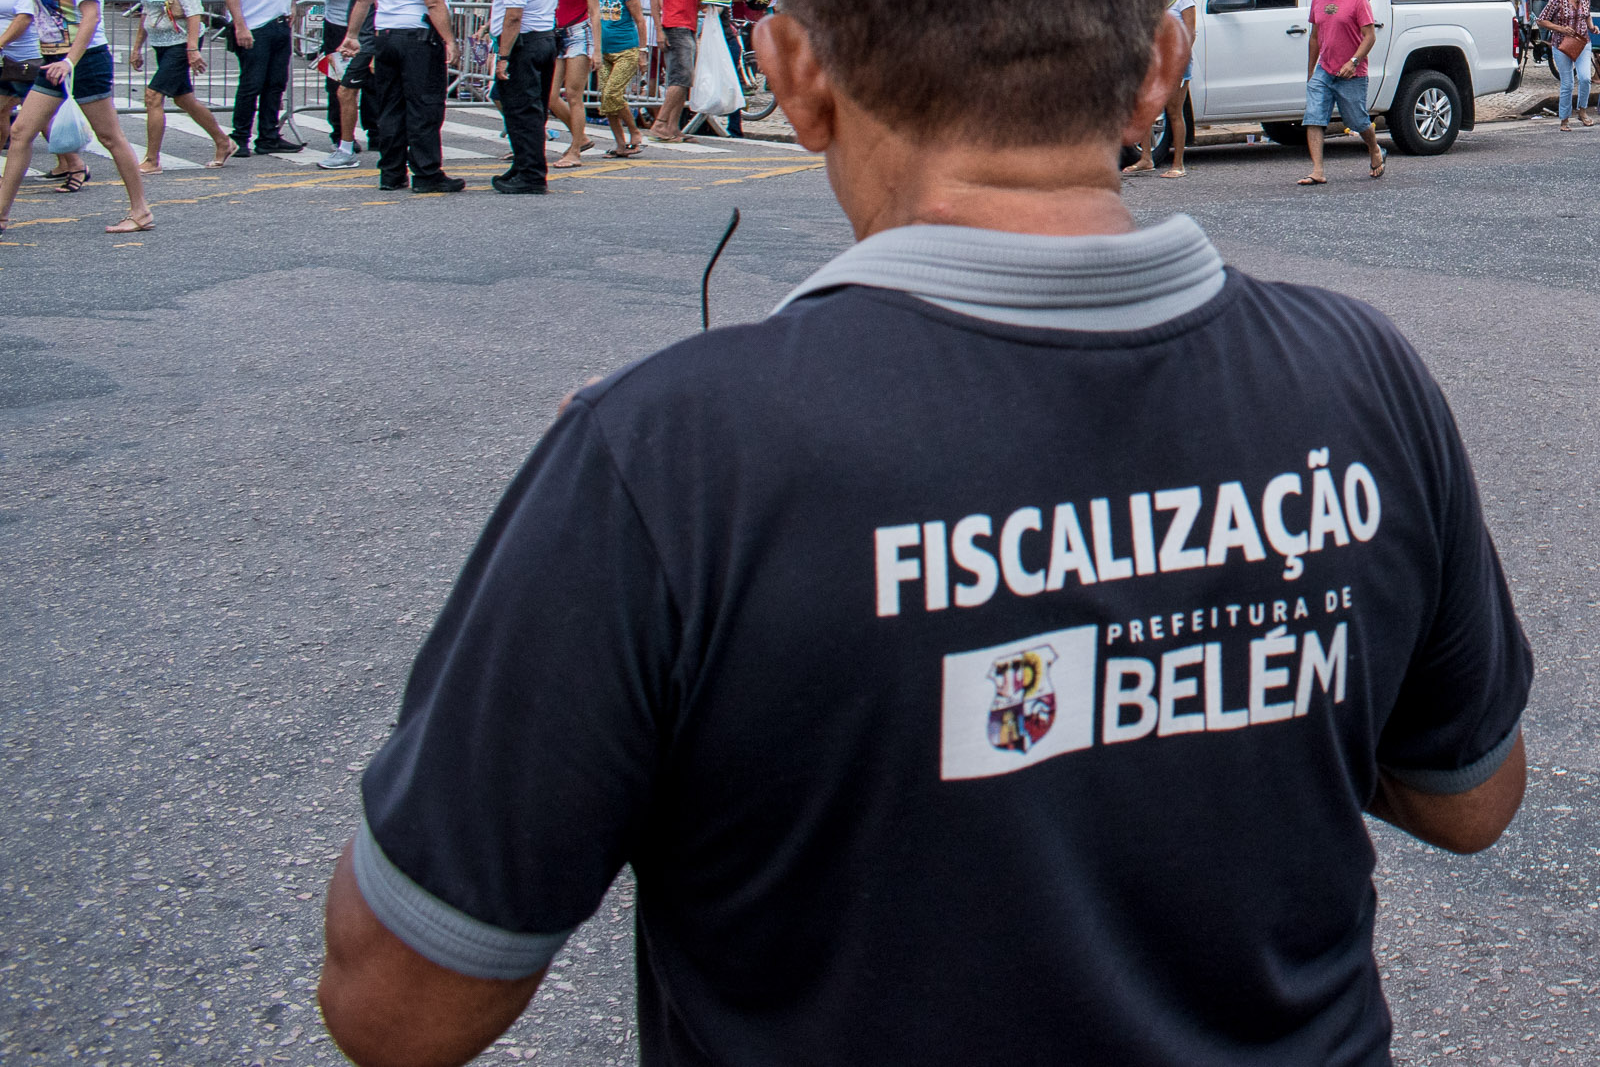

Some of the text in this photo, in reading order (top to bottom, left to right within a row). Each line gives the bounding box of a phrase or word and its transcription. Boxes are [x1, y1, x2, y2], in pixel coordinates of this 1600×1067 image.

[875, 446, 1382, 617] FISCALIZAÇÃO
[1106, 586, 1353, 645] PREFEITURA DE
[1103, 623, 1348, 745] BELÉM
